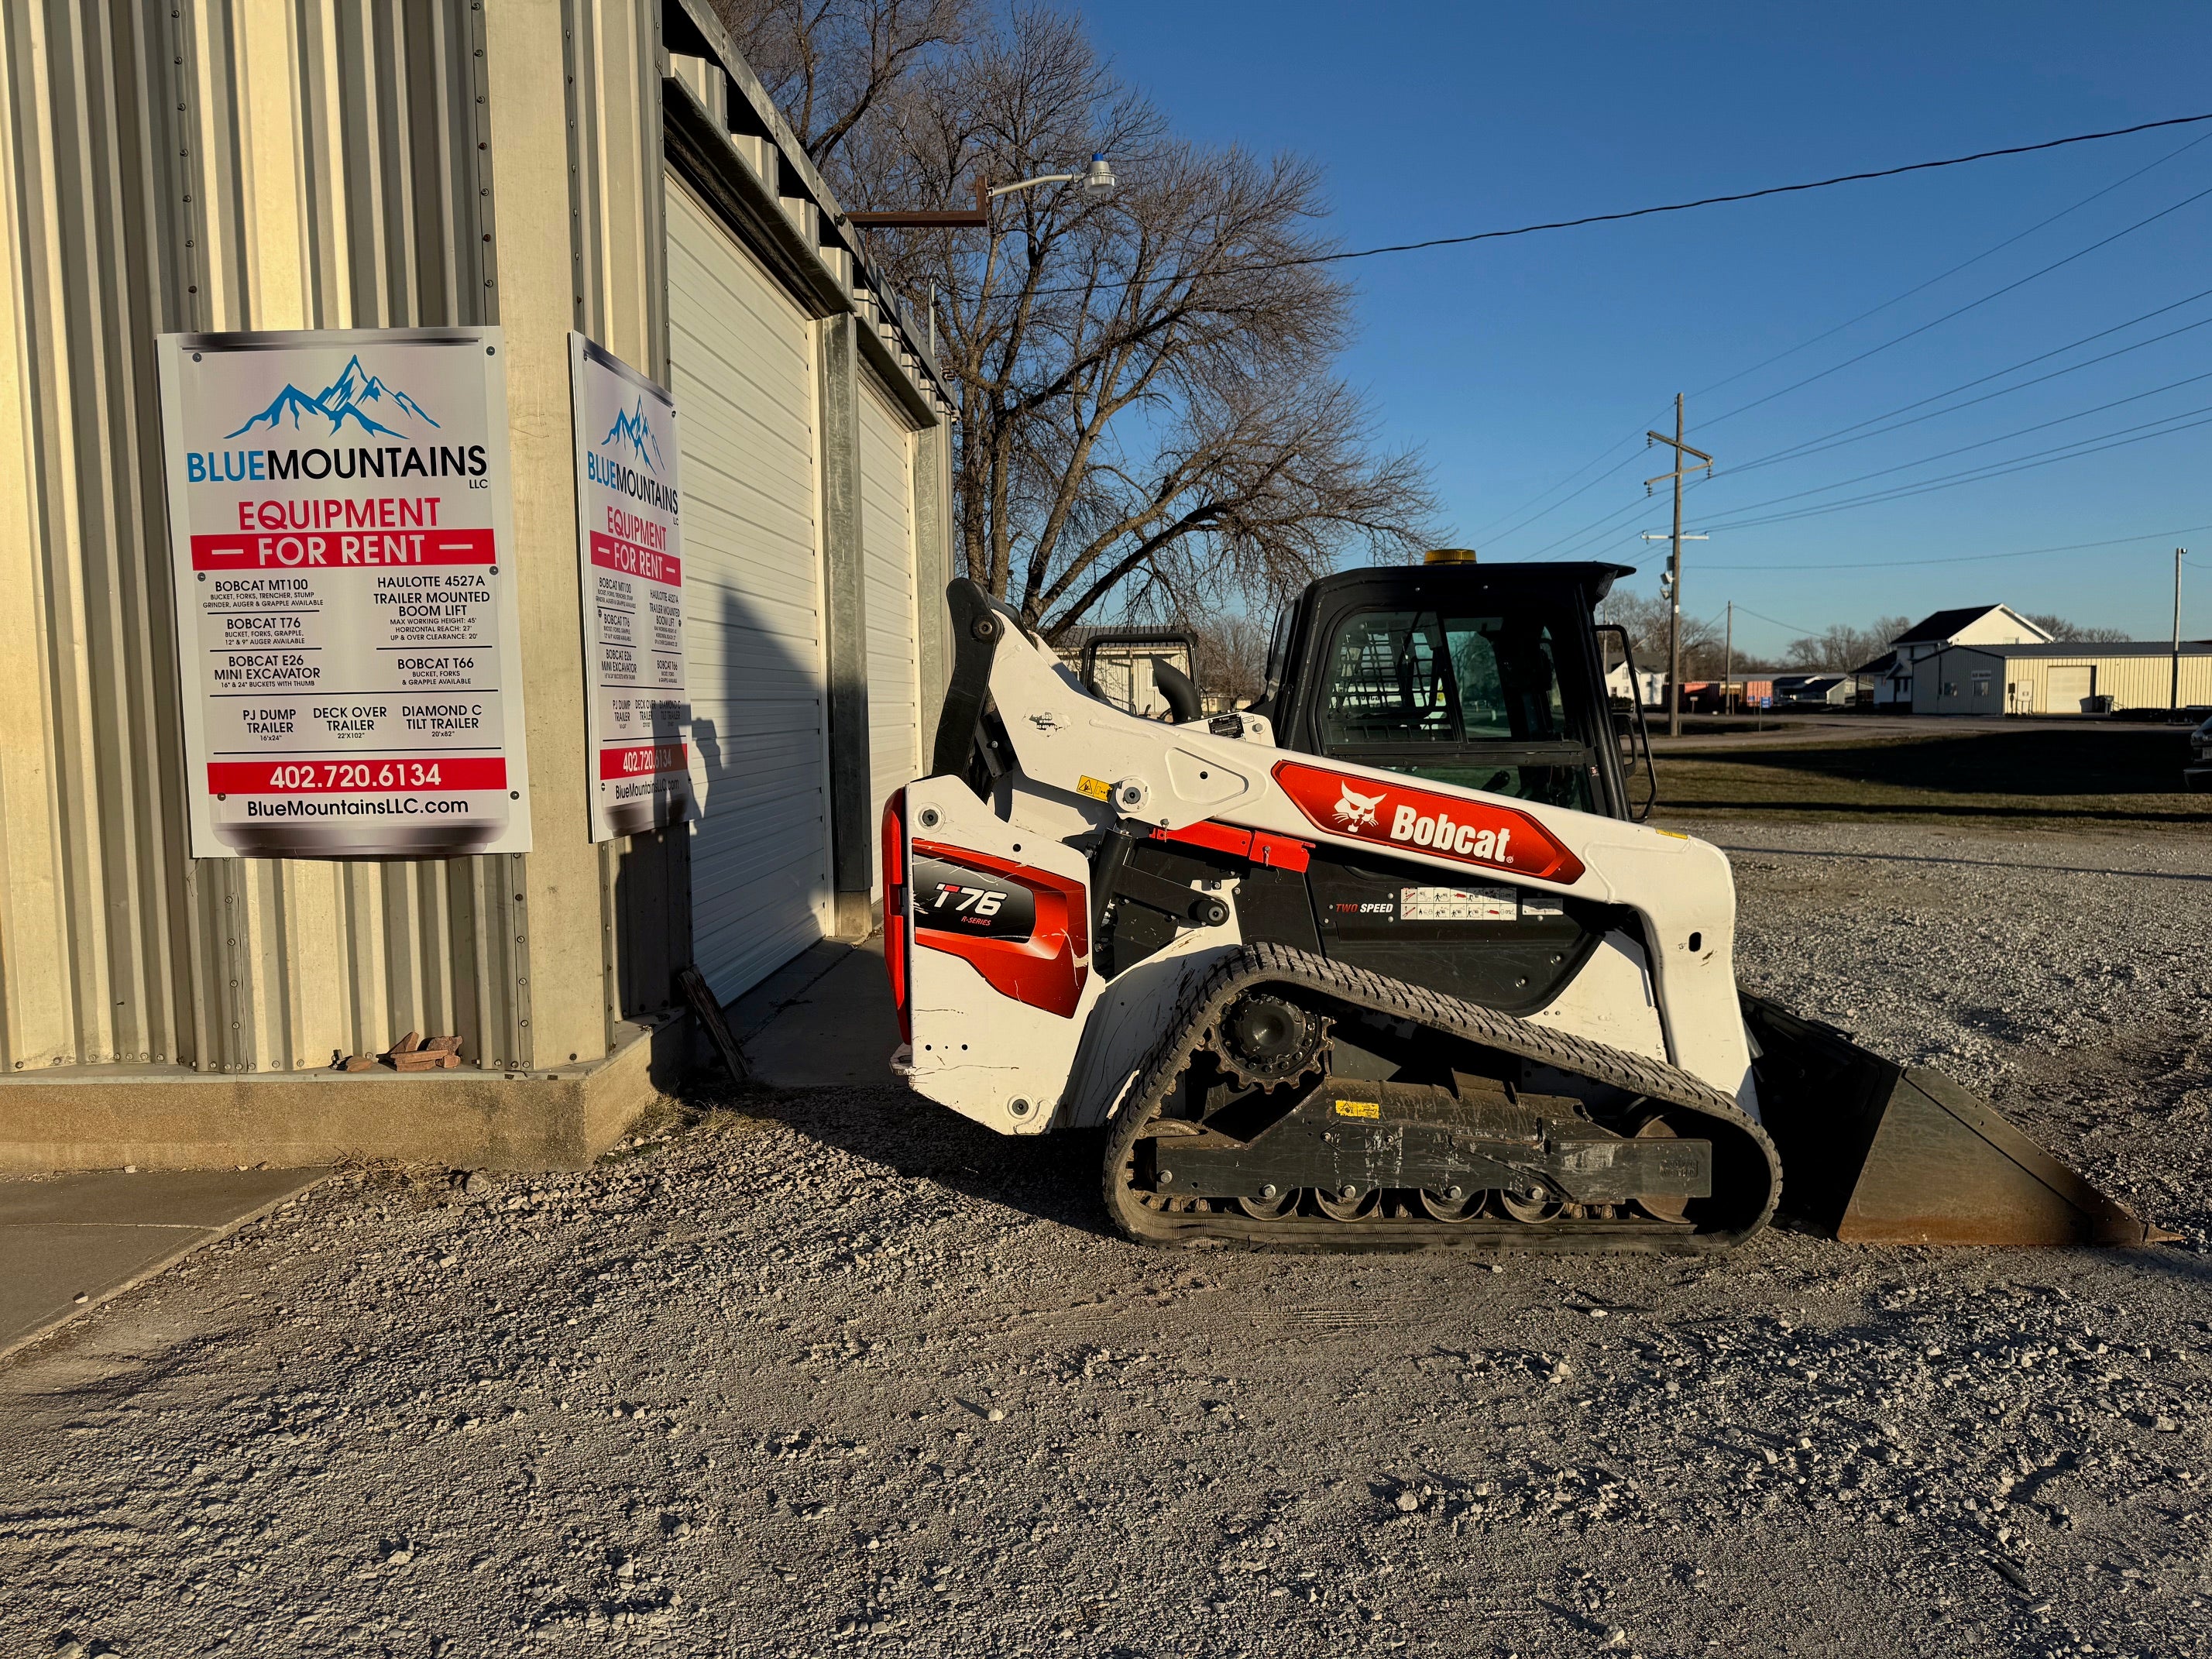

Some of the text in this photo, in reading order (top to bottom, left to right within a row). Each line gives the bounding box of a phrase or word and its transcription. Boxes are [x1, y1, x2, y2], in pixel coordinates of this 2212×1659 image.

[187, 445, 488, 483] BLUEMOUNTAINS
[469, 479, 489, 489] LLC
[588, 451, 678, 515] BLUEMOUNTAINS
[239, 496, 441, 531] EQUIPMENT
[607, 505, 666, 551] EQUIPMENT
[258, 534, 425, 566] FOR RENT
[614, 542, 663, 579] FOR RENT
[215, 579, 308, 592] BOBCAT MT100
[378, 575, 486, 588] HAULOTTE 4527A
[599, 577, 632, 593] BOBCAT MT100
[373, 592, 489, 604] TRAILER MOUNTED
[399, 605, 467, 617] BOOM LIFT
[227, 617, 301, 629] BOBCAT T76
[604, 613, 622, 625] BOBCAT
[657, 616, 668, 625] BOOM
[228, 654, 304, 667] BOBCAT E26
[606, 649, 623, 660] BOBCAT
[398, 658, 474, 669] BOBCAT T66
[602, 661, 637, 673] MINI EXCAVATOR
[657, 660, 671, 669] BOBCAT
[215, 668, 321, 680] MINI EXCAVATOR
[613, 700, 631, 710] PJ DUMP
[635, 699, 657, 709] DECK OVER
[242, 709, 297, 721] PJ DUMP
[313, 706, 387, 719] DECK OVER
[402, 704, 483, 717] DIAMOND C
[614, 712, 630, 722] TRAILER
[246, 722, 294, 733] TRAILER
[326, 720, 375, 732] TRAILER
[406, 717, 479, 730] TILT TRAILER
[623, 749, 672, 772] 402.720.6134
[270, 763, 441, 788] 402.720.6134
[616, 779, 679, 799] BlueMountainsLLC.com
[247, 798, 469, 817] BlueMountainsLLC.com
[1390, 804, 1511, 863] Bobcat
[934, 883, 1008, 915] T76
[1336, 903, 1393, 913] TWO SPEED
[961, 915, 991, 926] R-SERIES
